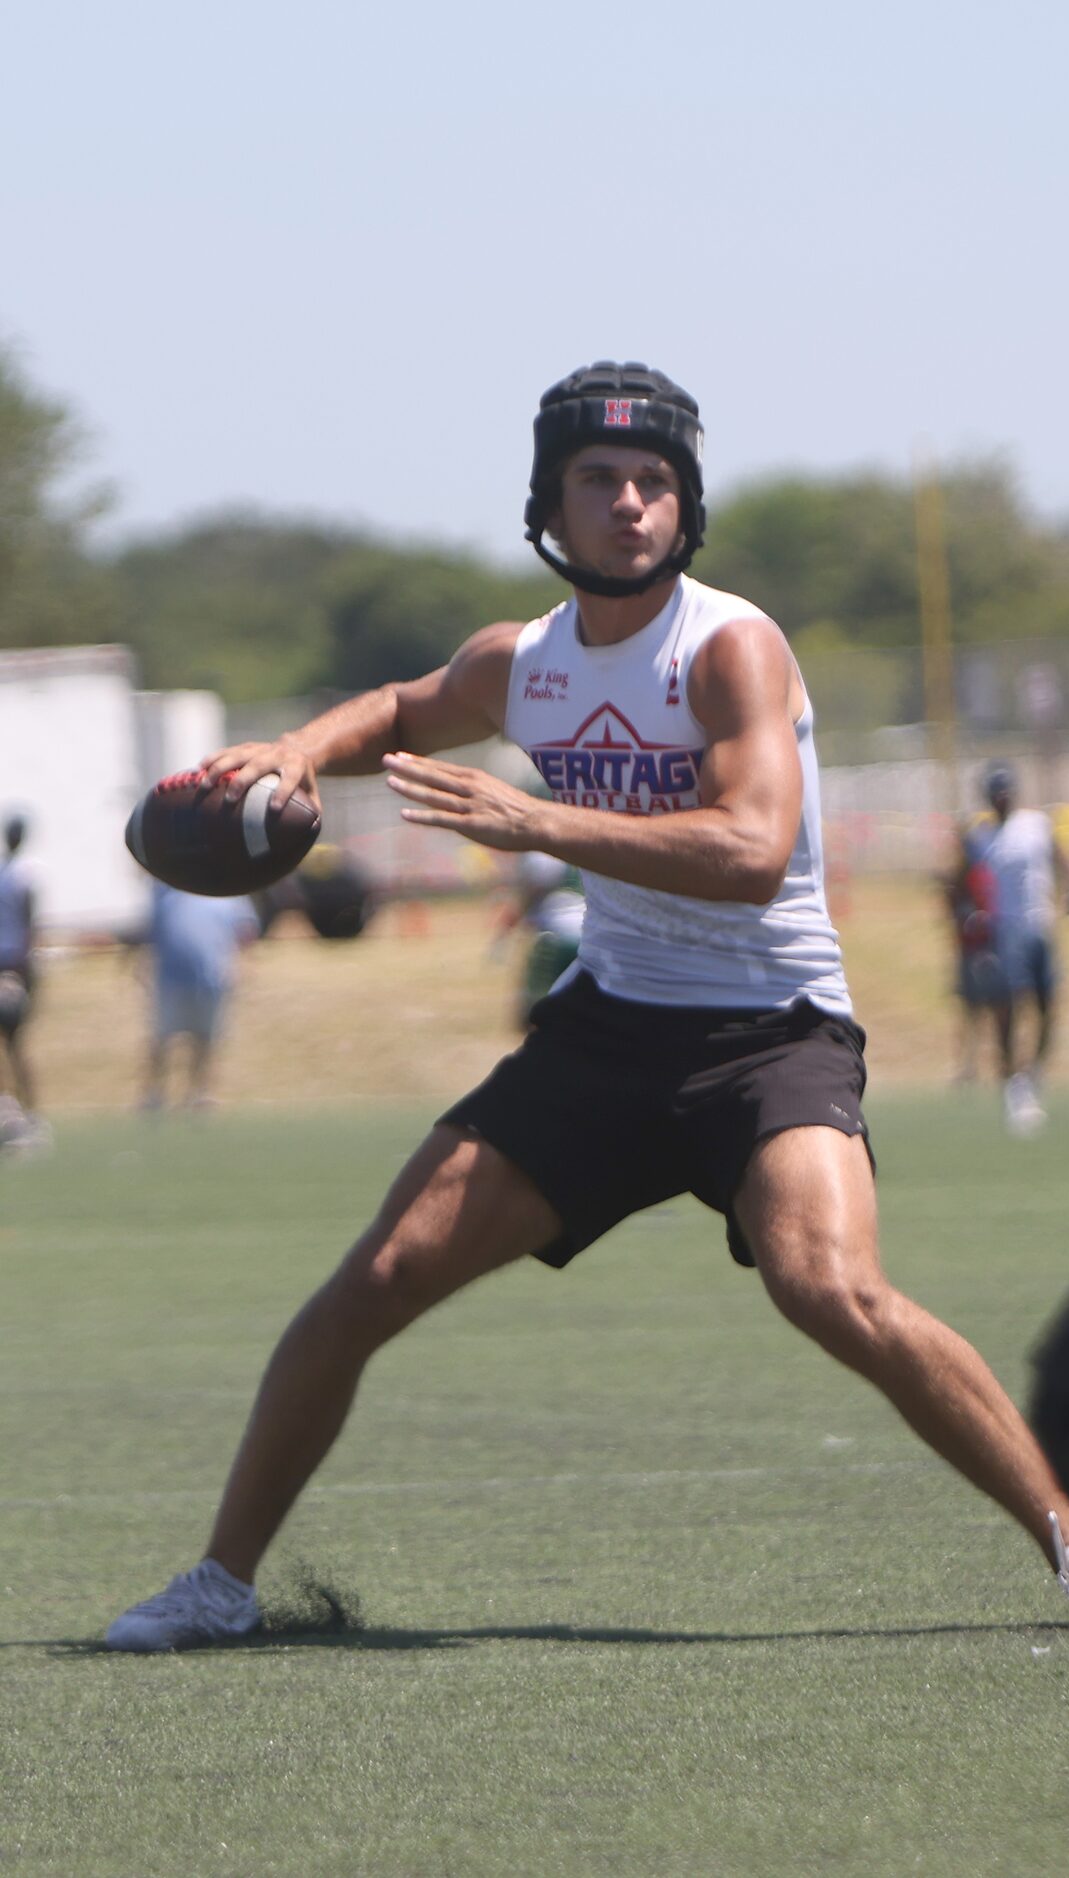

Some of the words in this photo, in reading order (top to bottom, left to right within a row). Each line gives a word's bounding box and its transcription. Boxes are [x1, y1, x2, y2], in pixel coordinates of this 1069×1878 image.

[604, 399, 631, 425] H
[545, 669, 569, 689] King
[530, 750, 704, 795] ERITAG
